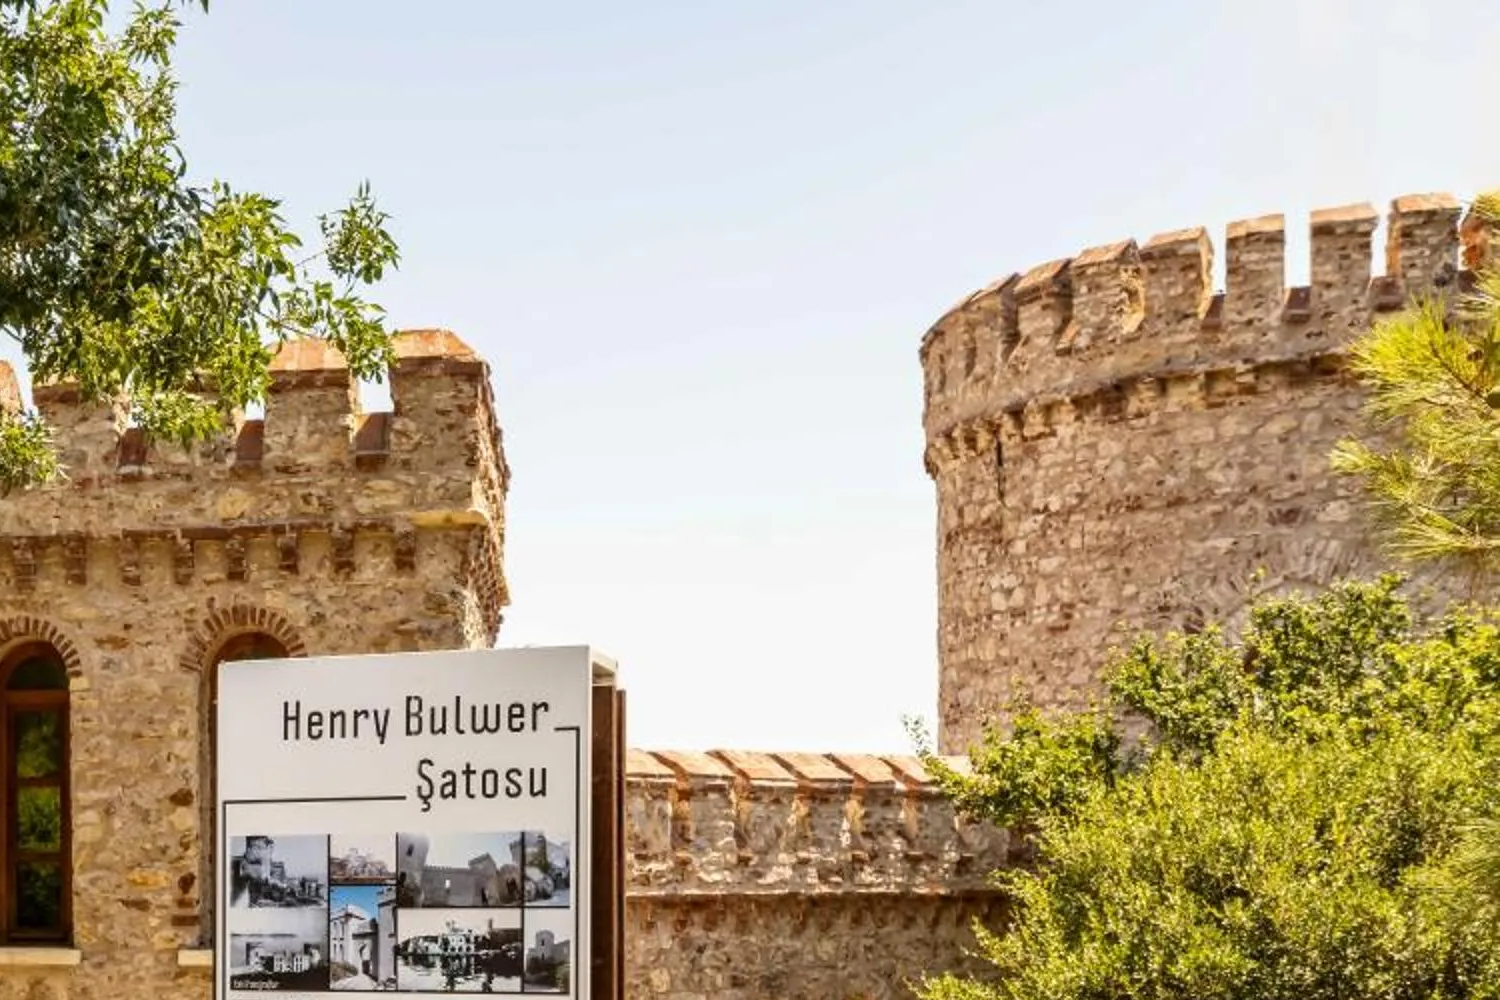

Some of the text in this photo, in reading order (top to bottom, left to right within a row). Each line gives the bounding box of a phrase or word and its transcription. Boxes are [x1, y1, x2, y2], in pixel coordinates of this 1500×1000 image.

[283, 695, 549, 744] Henry Bulwer
[417, 758, 547, 812] Şatosu
